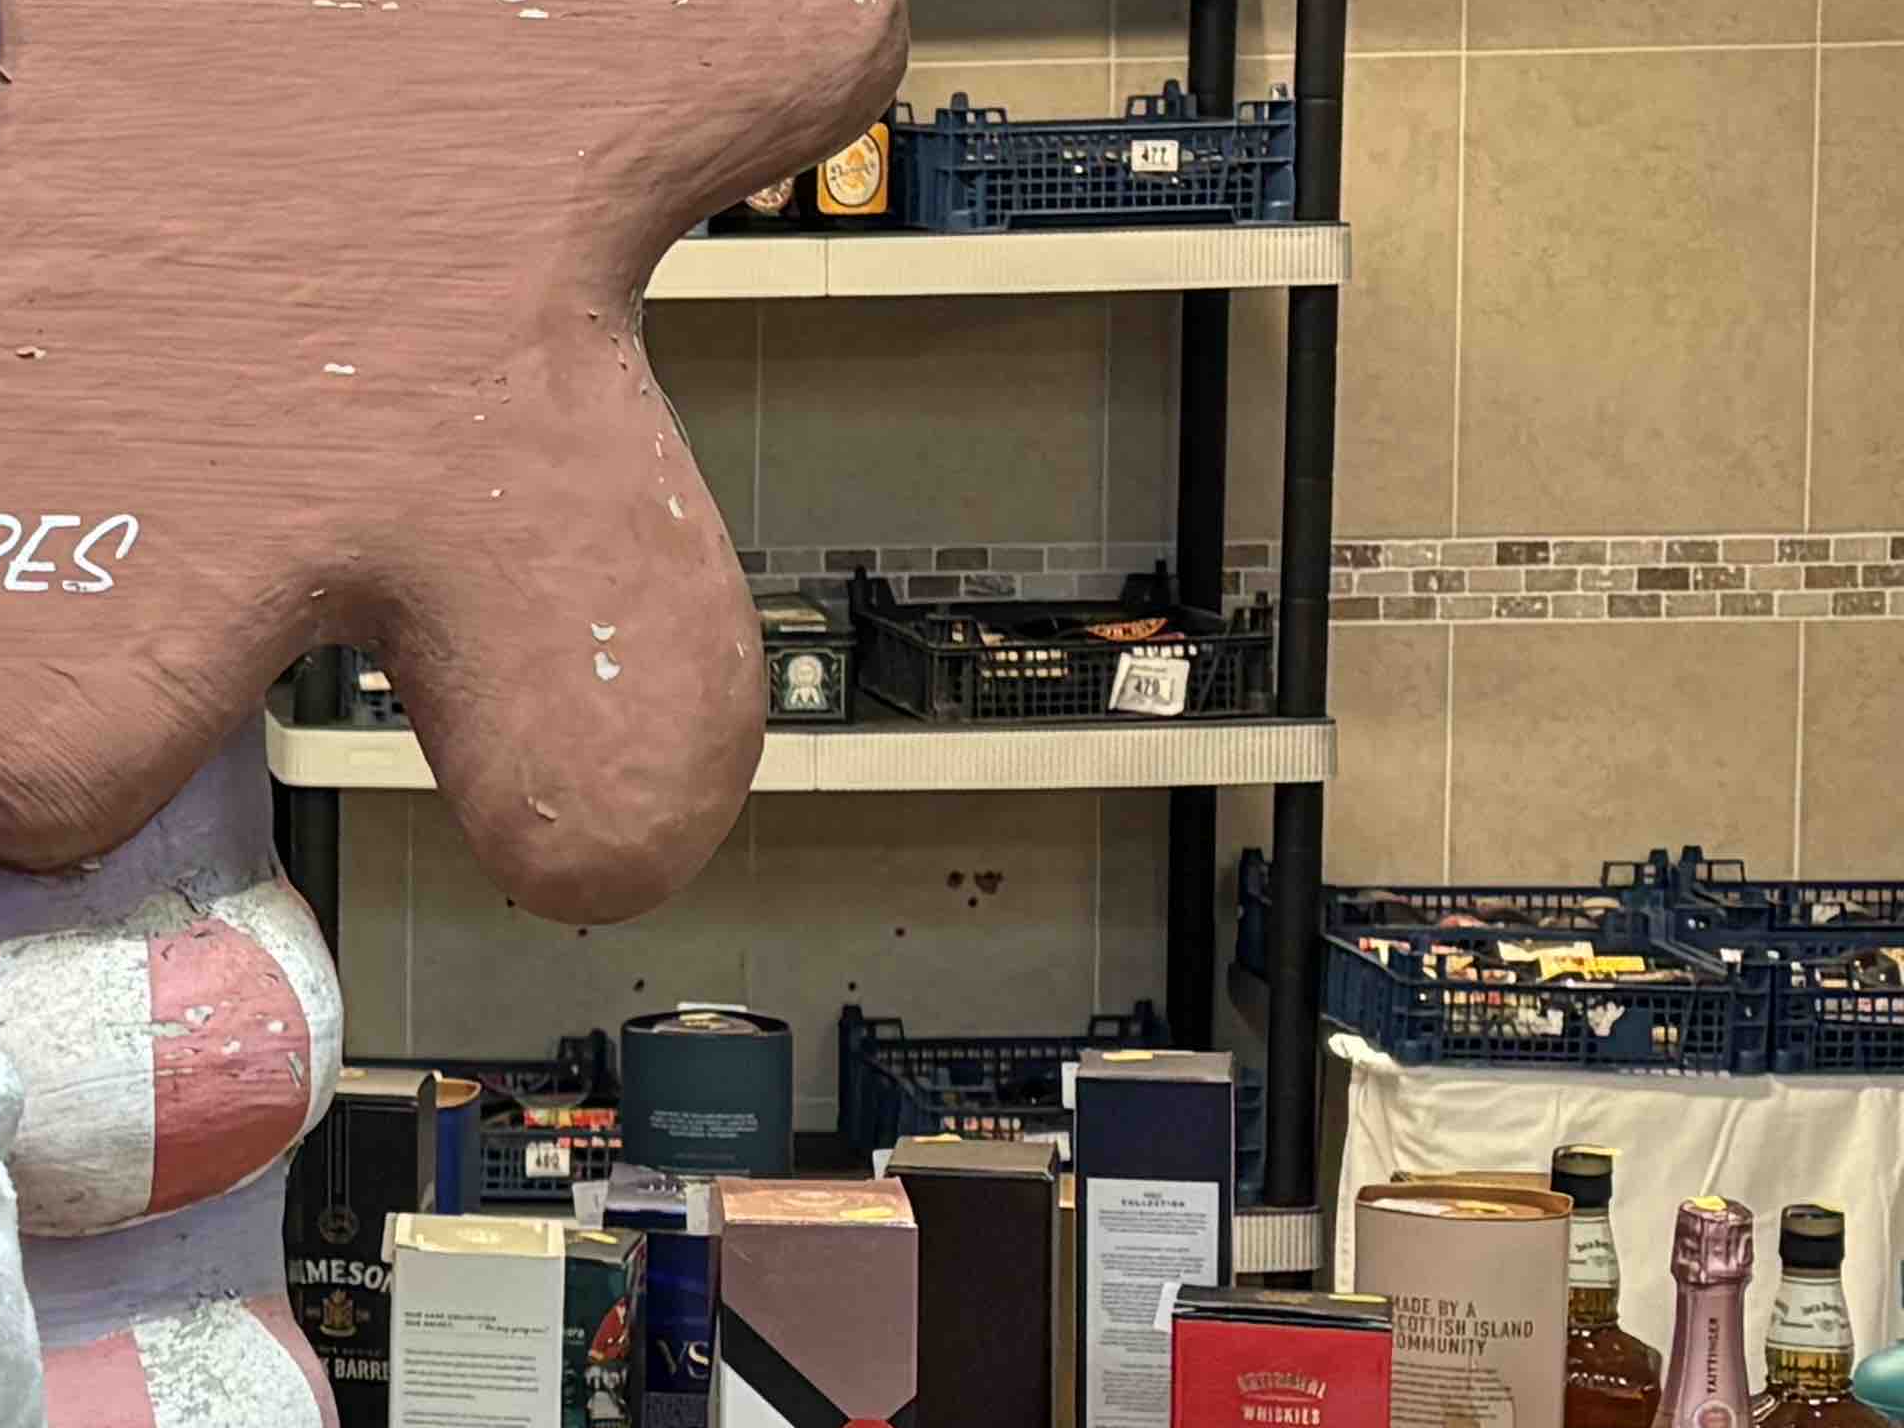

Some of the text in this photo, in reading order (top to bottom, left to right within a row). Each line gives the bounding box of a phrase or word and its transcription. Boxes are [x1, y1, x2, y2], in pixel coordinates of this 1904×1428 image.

[1438, 1299, 1458, 1317] BY
[1465, 1301, 1477, 1319] A
[1395, 1314, 1534, 1339] COTTISH ISLAND
[1395, 1332, 1487, 1356] OMMUNITY
